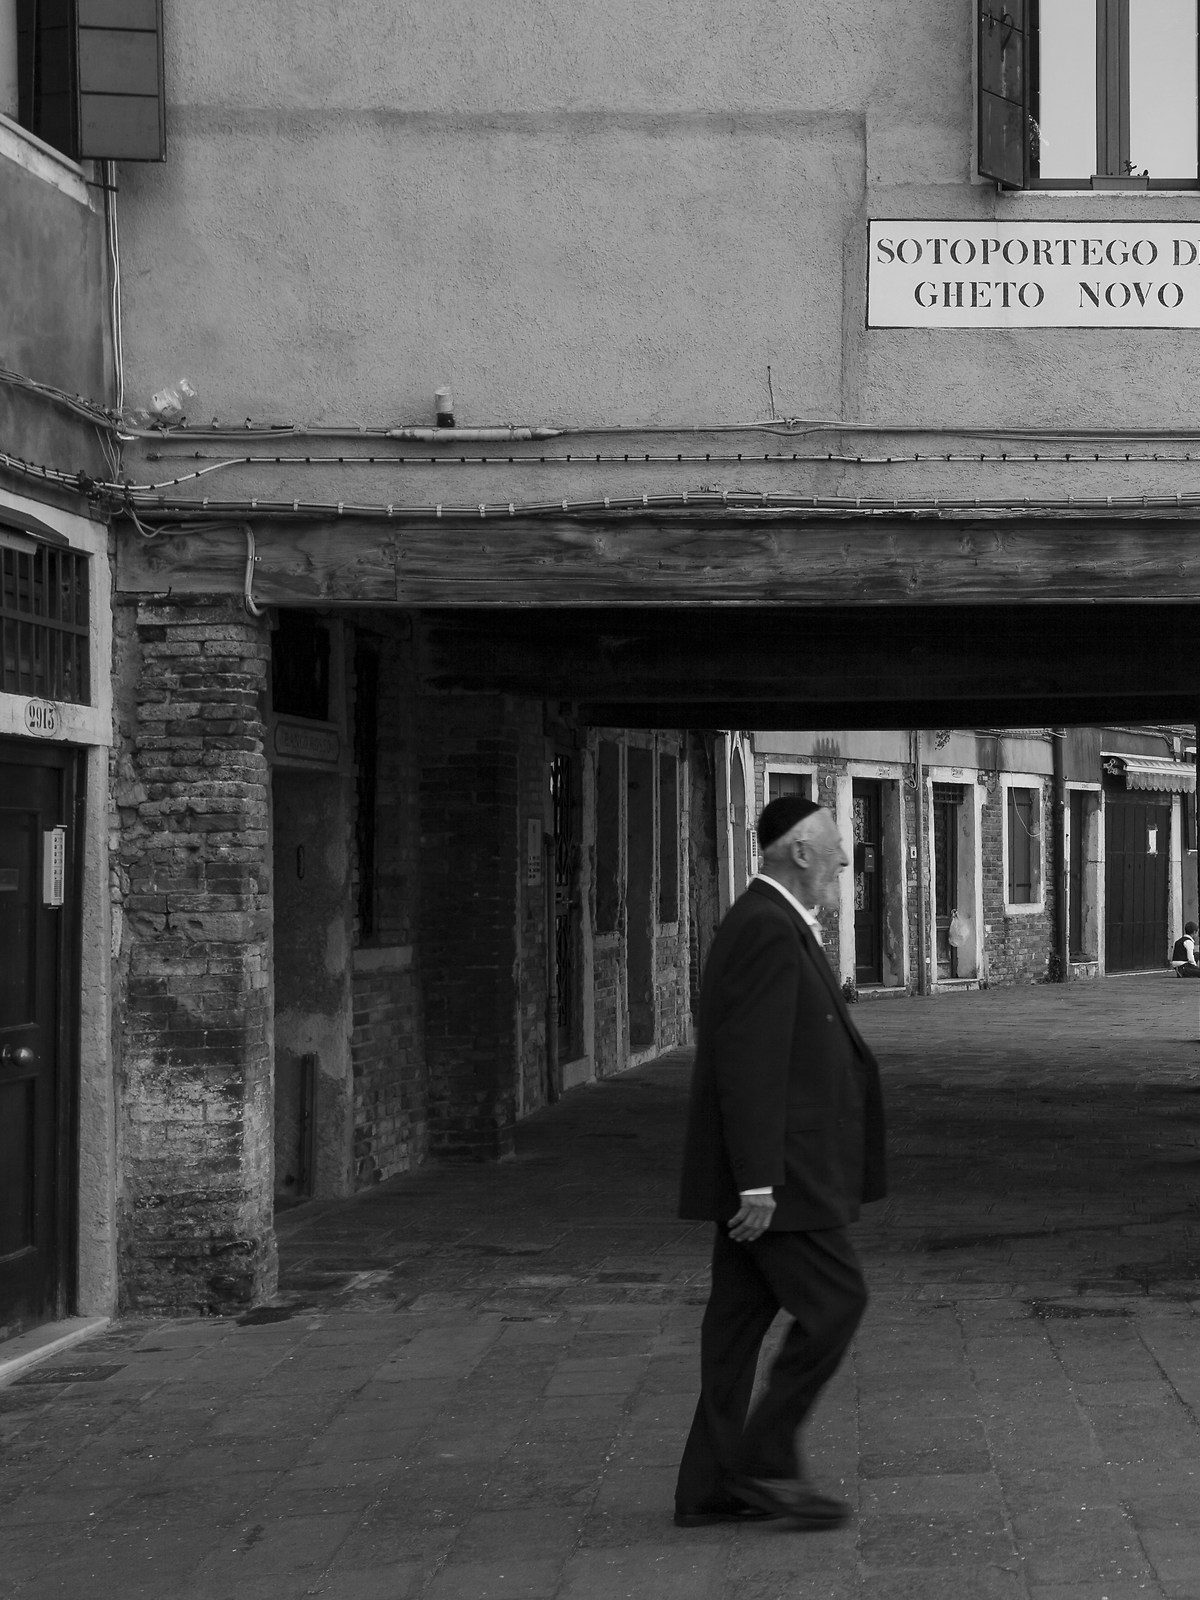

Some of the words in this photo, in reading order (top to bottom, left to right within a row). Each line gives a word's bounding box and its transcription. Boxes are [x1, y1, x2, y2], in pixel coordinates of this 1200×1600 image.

[876, 238, 1158, 266] SOTOPORTEGO
[914, 281, 1045, 308] GHETO
[1078, 282, 1184, 308] NOVO
[28, 704, 55, 730] 2913
